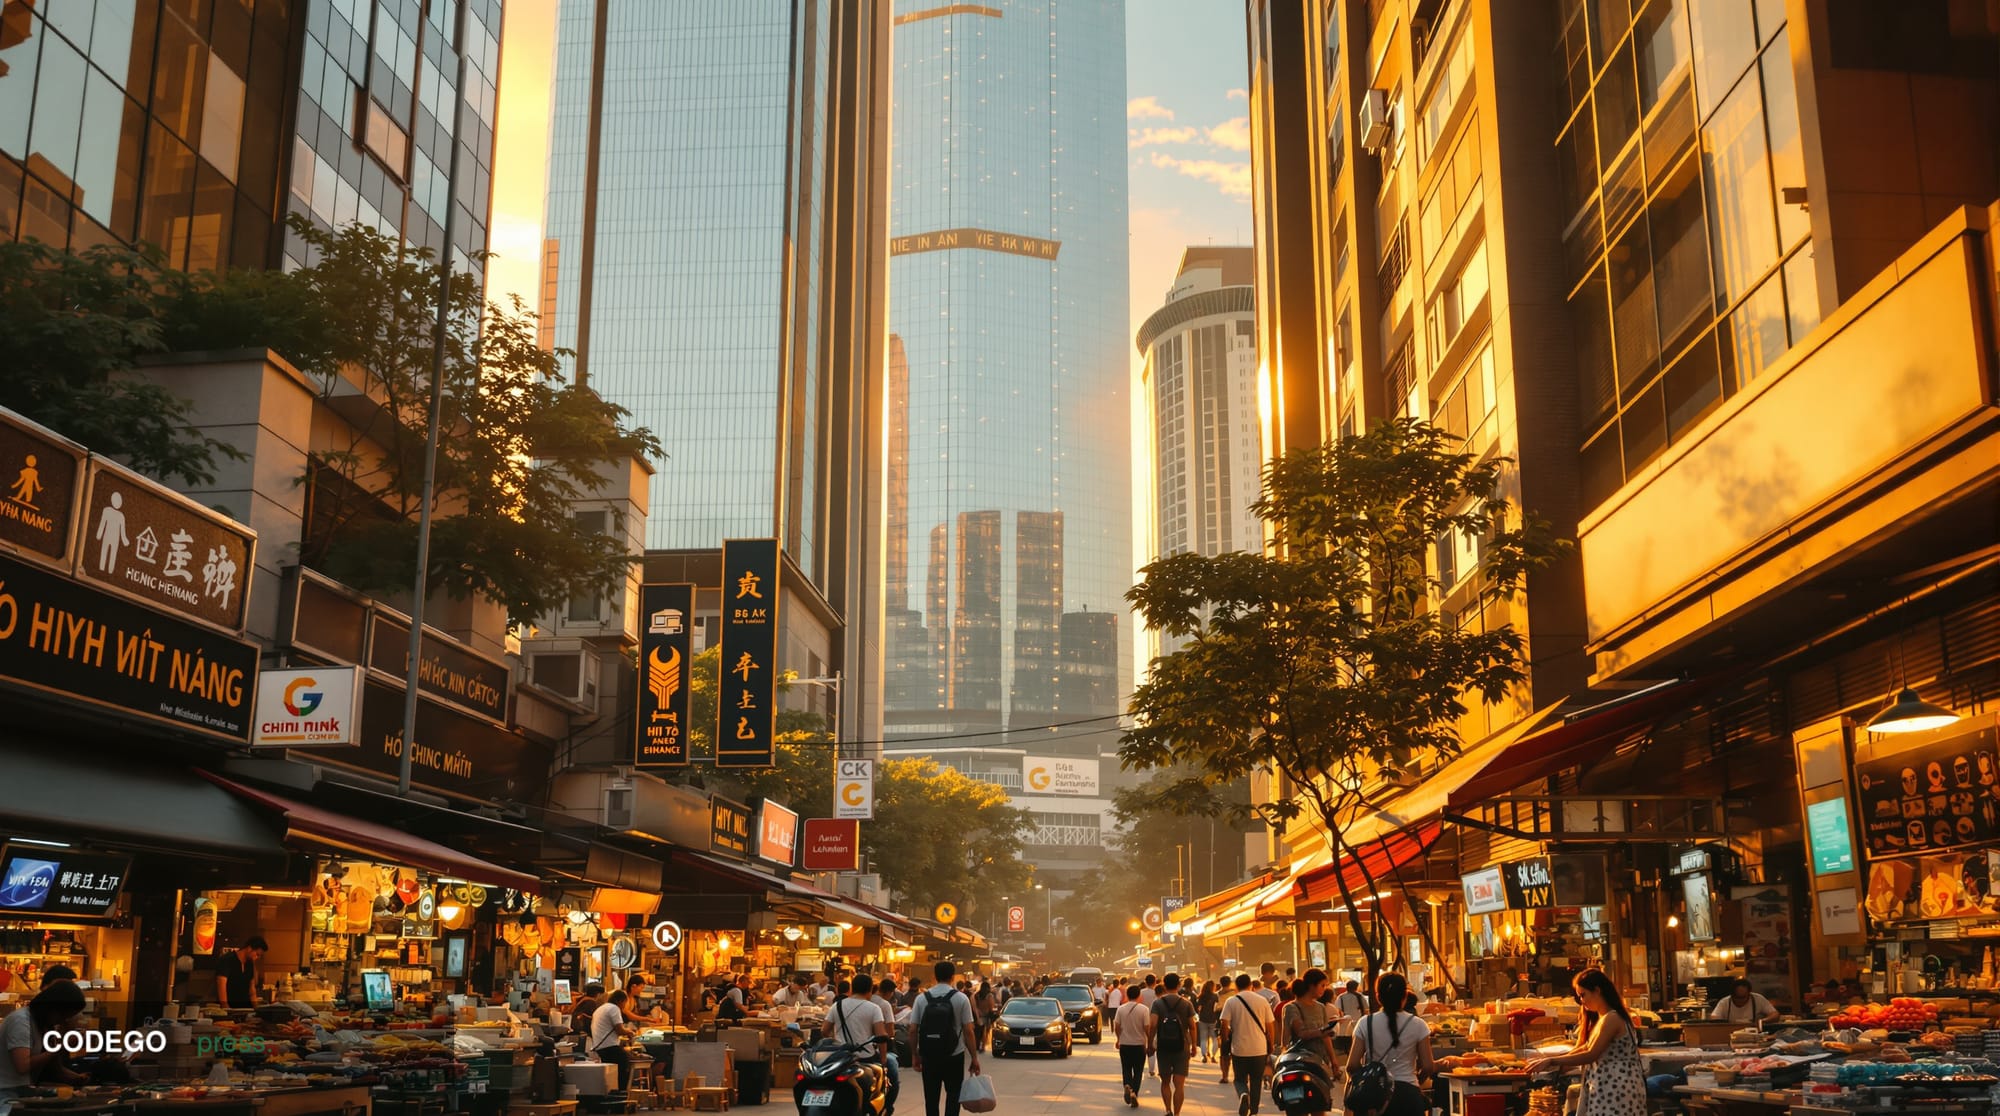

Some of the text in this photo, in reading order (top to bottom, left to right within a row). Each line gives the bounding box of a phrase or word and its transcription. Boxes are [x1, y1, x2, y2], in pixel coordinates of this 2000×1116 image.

[29, 602, 107, 668] HIYH
[841, 762, 868, 776] CK
[1522, 886, 1549, 907] TAY
